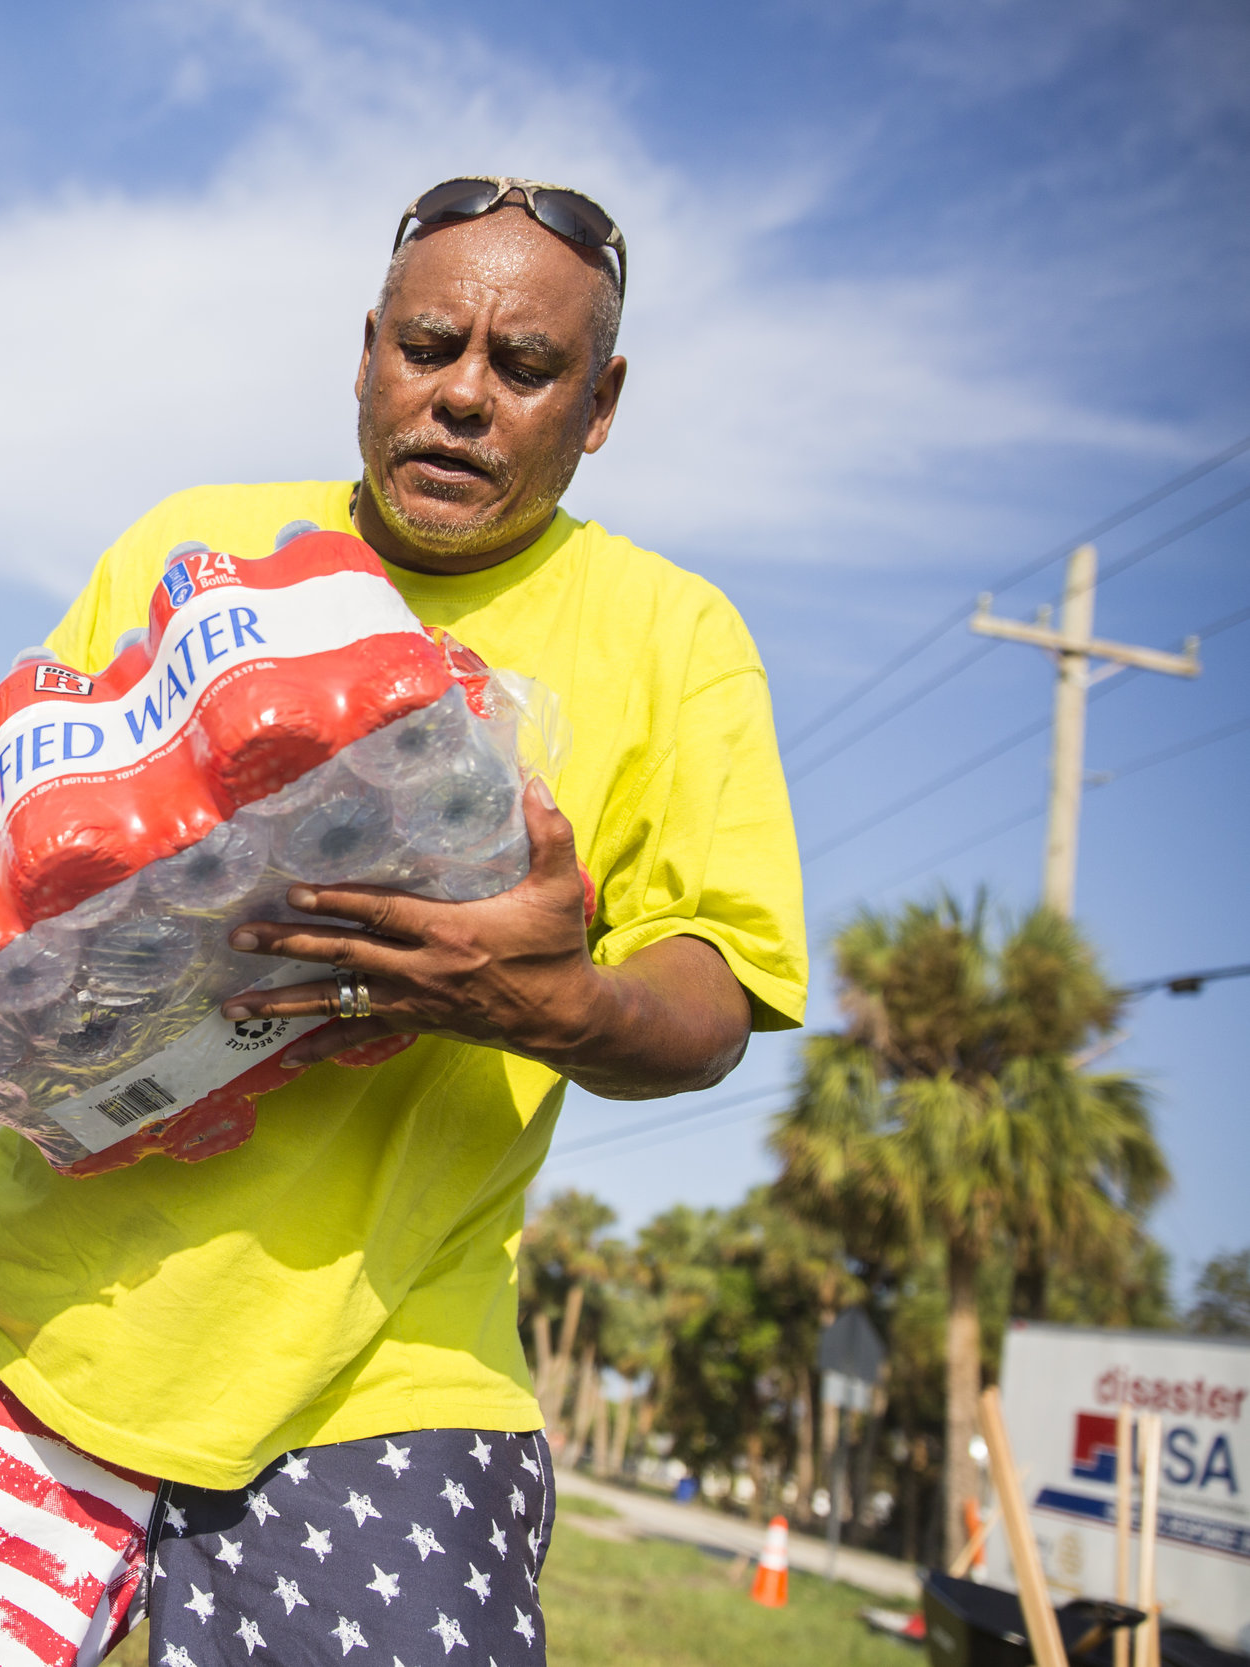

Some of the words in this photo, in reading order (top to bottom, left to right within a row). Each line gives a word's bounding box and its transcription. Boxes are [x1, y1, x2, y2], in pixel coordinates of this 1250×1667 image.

[189, 553, 237, 580] 24
[199, 573, 242, 589] Bottles
[39, 672, 83, 693] R
[125, 607, 266, 745] WATER
[61, 775, 107, 786] BOTTLES
[115, 764, 147, 781] TOTAL
[148, 736, 183, 763] VOLUME
[255, 661, 277, 669] GAL
[225, 1036, 274, 1052] RECYCLE
[1096, 1365, 1248, 1421] disaster
